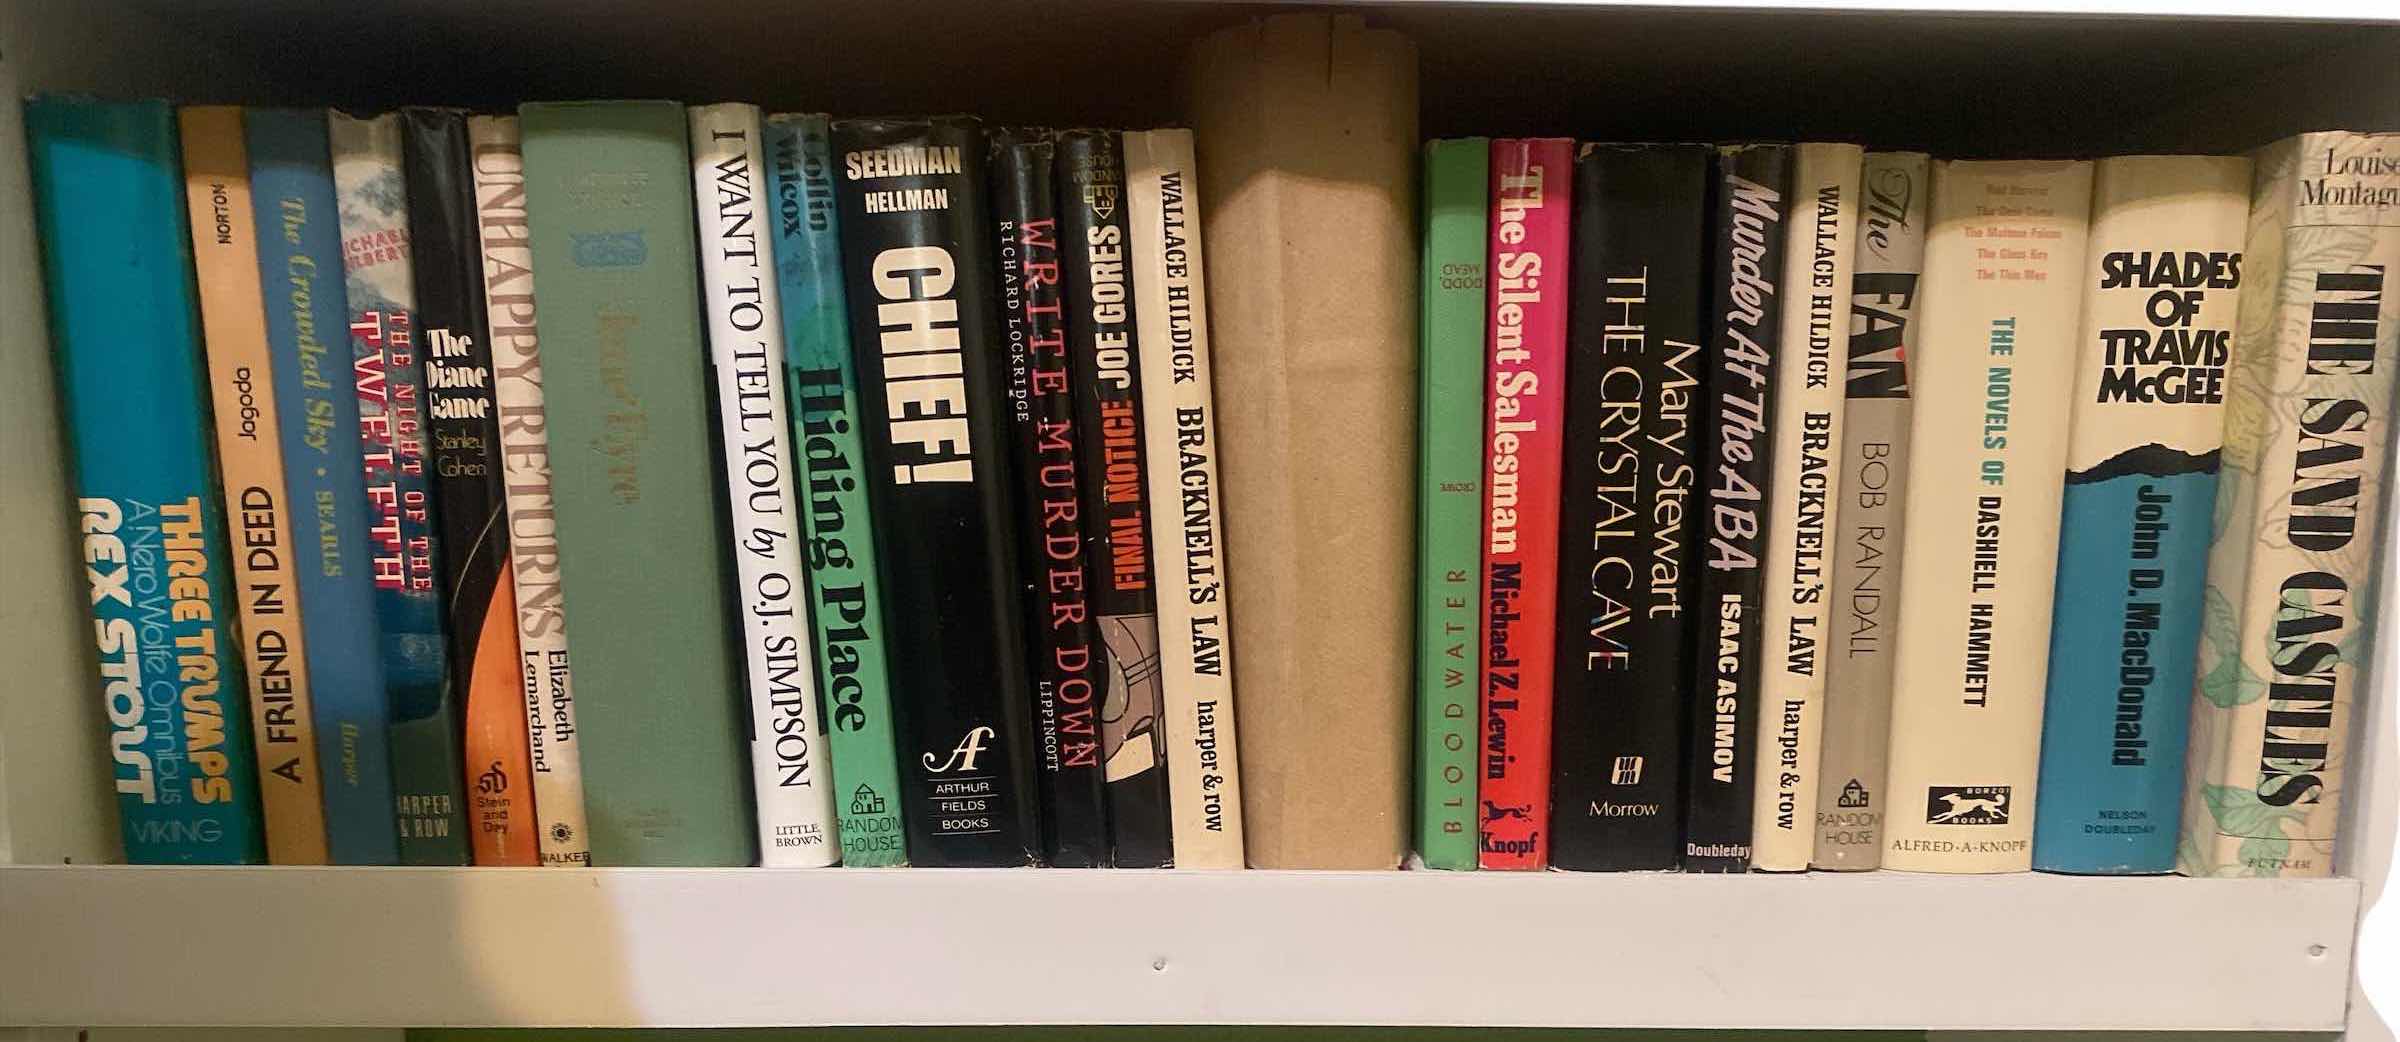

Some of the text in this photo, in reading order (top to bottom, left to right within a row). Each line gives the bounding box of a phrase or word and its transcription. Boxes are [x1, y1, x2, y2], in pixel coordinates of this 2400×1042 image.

[216, 184, 233, 245] NORTON
[846, 147, 962, 181] SEEDMAN
[864, 189, 949, 214] HELLMAN
[281, 197, 337, 455] The Crowded Sky
[1000, 220, 1029, 423] RICHARD LOCKRIDGE
[1087, 224, 1131, 390] JOE GORES
[1845, 166, 1921, 399] The FAN
[2100, 251, 2243, 289] SHADES
[2145, 289, 2204, 328] OF
[425, 360, 489, 389] Diane
[427, 328, 473, 357] The
[473, 143, 567, 639] UNHAPPY RETURNS
[872, 246, 974, 485] CHIEF!
[1490, 165, 1545, 555] The Silent Salesman
[1708, 174, 1781, 572] Murder At The ABA
[2096, 366, 2225, 405] McGEE
[2099, 328, 2231, 366] TRAVIS
[232, 366, 260, 441] Jagoda
[388, 310, 433, 592] THE NIGHT OF THE
[434, 425, 488, 457] Stanley
[711, 129, 812, 789] I WANT TO TELL YOU by O.J. SIMPSON
[437, 454, 488, 478] Cohen
[1019, 217, 1099, 770] WRITE MURDER DOWN
[1101, 400, 1147, 591] FINAL NOTICE
[1160, 171, 1224, 833] WALLACE HILDICK BRACKNELL'S LAW harper & row
[1588, 265, 1649, 671] THE CRYSTAL CAVE
[1646, 339, 1702, 620] Mary Stewart
[1777, 184, 1841, 831] WALLACE HILDICK BRACKNELL'S LAW harper & row
[1963, 316, 2017, 708] THE NOVELS OF DASHIELL HAMMETT
[799, 363, 871, 734] Hiding Place
[1850, 443, 1890, 660] BOB RANDALL
[2255, 264, 2386, 807] THE SAND CASTLES
[79, 497, 156, 804] REX STOUT
[125, 499, 184, 806] A Nero Wolfe Omnibus
[160, 497, 233, 804] THREE TRUMPS
[240, 486, 302, 783] A FRIEND IN DEED
[1488, 561, 1522, 669] Michael
[2111, 485, 2172, 767] John D. MacDonald
[525, 649, 552, 774] Lemarchand
[548, 649, 574, 743] Elizabeth
[1039, 679, 1060, 774] LIPPINCOTT
[1442, 568, 1467, 835] BLOODWATER
[1487, 698, 1519, 781] Lewin
[1712, 593, 1742, 784] ISAAC ASIMOV
[131, 818, 224, 844] VIKING
[414, 818, 449, 838] ROW
[775, 834, 824, 848] BROWN
[844, 834, 903, 852] HOUSE
[935, 781, 990, 795] ARTHUR
[941, 800, 987, 812] FIELDS
[942, 817, 990, 830] BOOKS
[1480, 831, 1539, 857] Knopf
[1589, 800, 1660, 817] Morrow
[2084, 824, 2157, 834] DOUBLEDAY
[2098, 810, 2148, 820] NELSON
[1687, 842, 1752, 860] Doubleday
